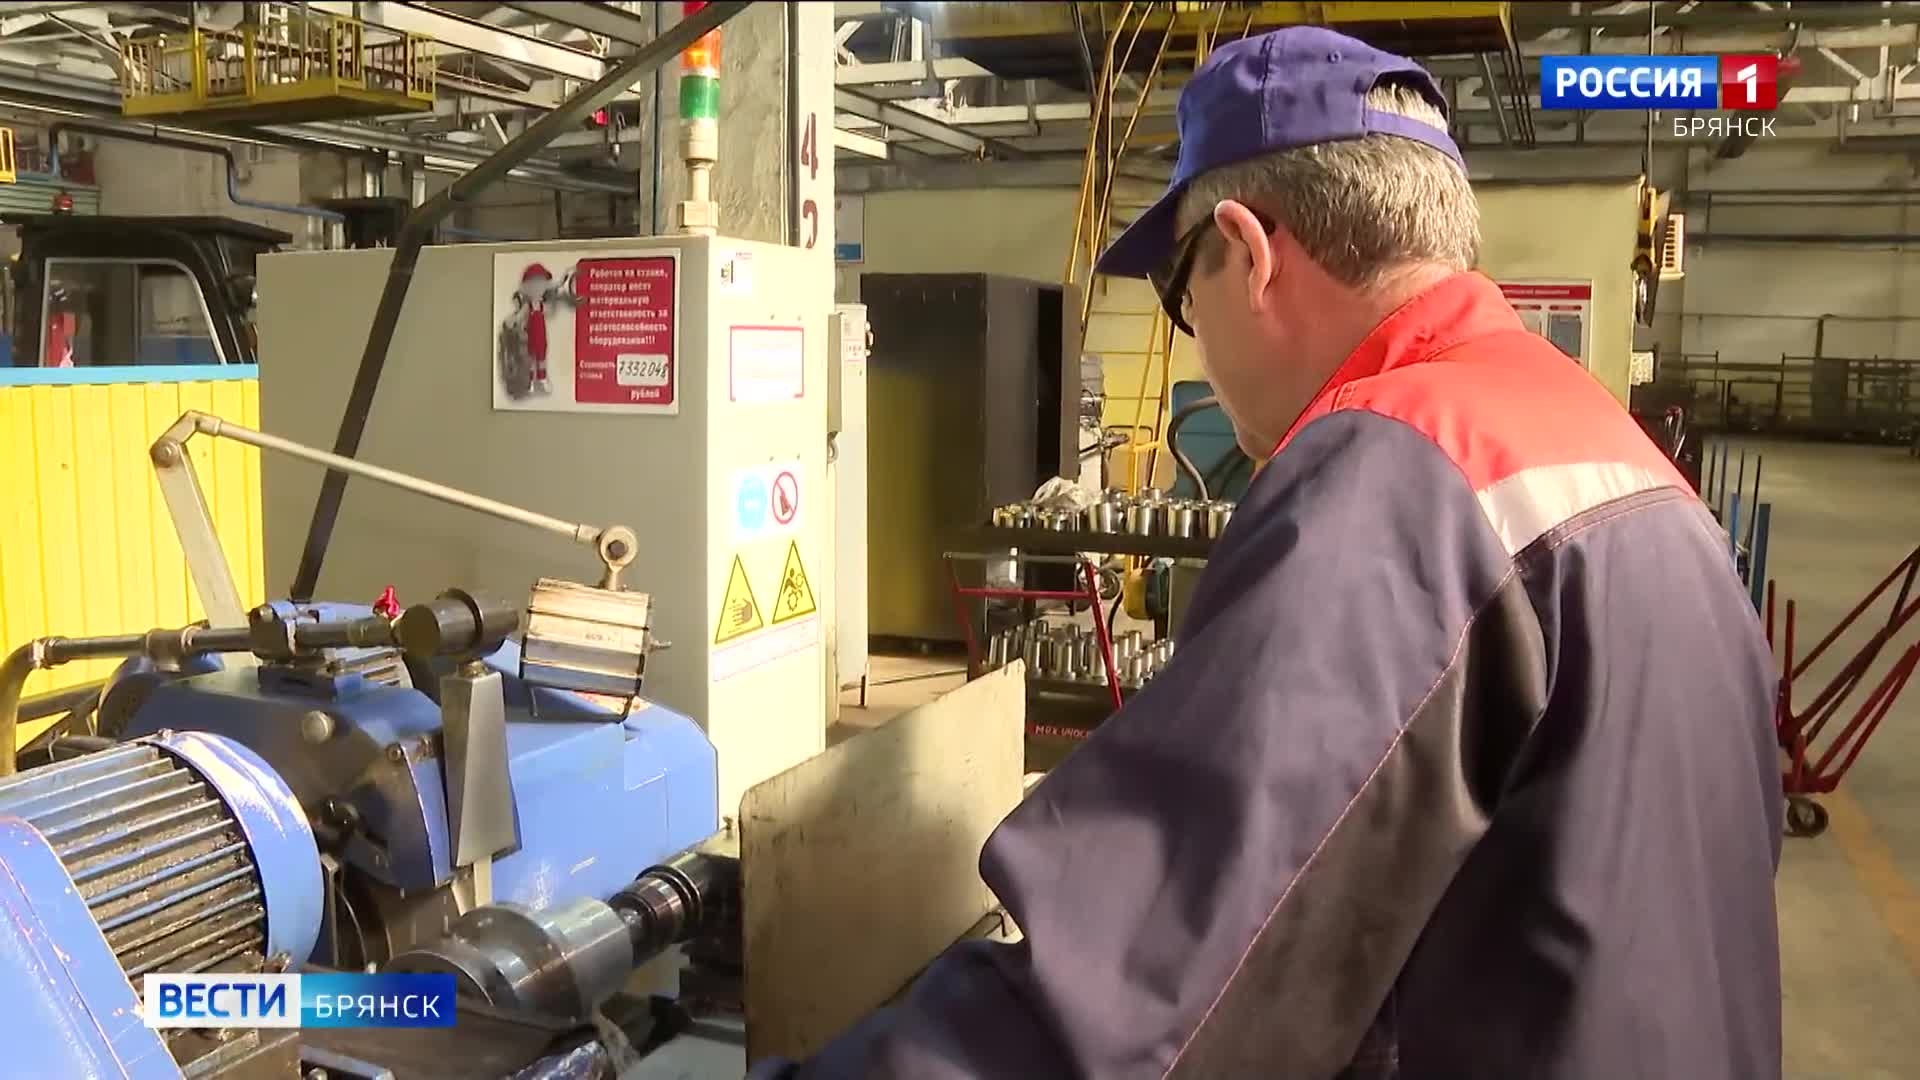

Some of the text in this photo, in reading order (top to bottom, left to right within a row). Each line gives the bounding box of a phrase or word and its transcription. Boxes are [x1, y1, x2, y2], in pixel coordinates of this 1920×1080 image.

[658, 309, 668, 317] за
[589, 322, 668, 334] работоспособность
[630, 388, 660, 401] рублей
